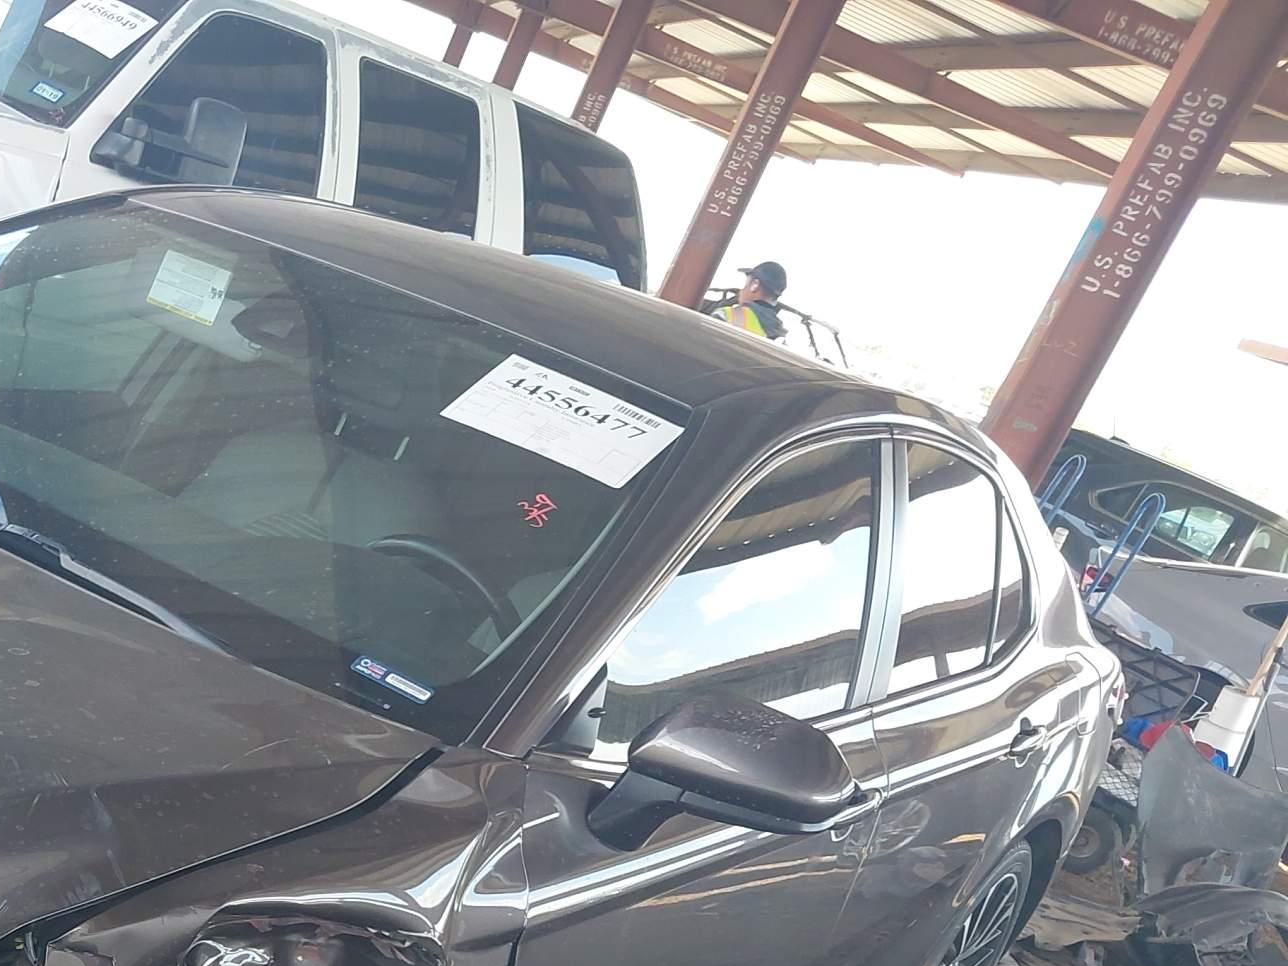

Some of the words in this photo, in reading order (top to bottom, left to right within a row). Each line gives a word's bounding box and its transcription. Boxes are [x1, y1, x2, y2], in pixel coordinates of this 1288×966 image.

[720, 95, 786, 217] 1-866-799-0969
[723, 123, 757, 181] PREFAB
[1081, 250, 1119, 293] U.S.
[1112, 143, 1173, 237] PREFAB
[1168, 87, 1209, 133] INC.
[1103, 93, 1227, 298] 1-866-799-0969
[505, 377, 648, 439] 44556477
